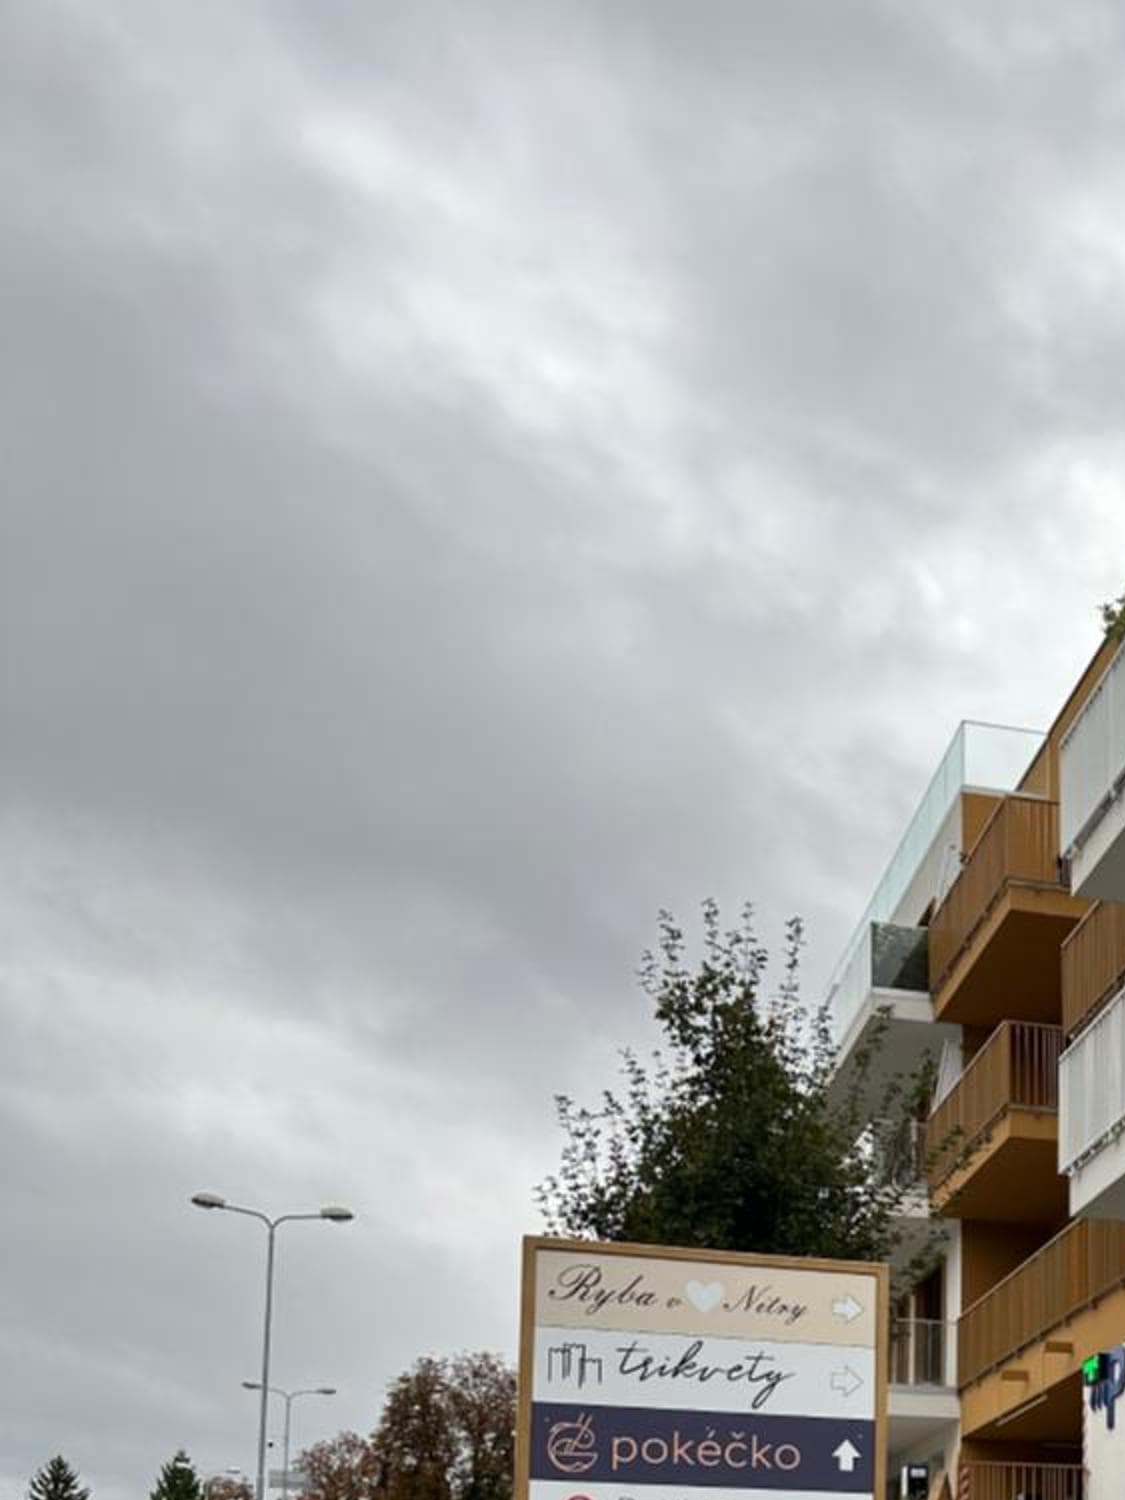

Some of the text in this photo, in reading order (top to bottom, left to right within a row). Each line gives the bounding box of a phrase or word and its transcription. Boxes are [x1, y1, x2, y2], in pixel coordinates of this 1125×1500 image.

[548, 1263, 657, 1315] Ryba
[723, 1284, 808, 1323] Nitry
[616, 1340, 796, 1409] trikvety
[611, 1430, 801, 1471] pokéčko
